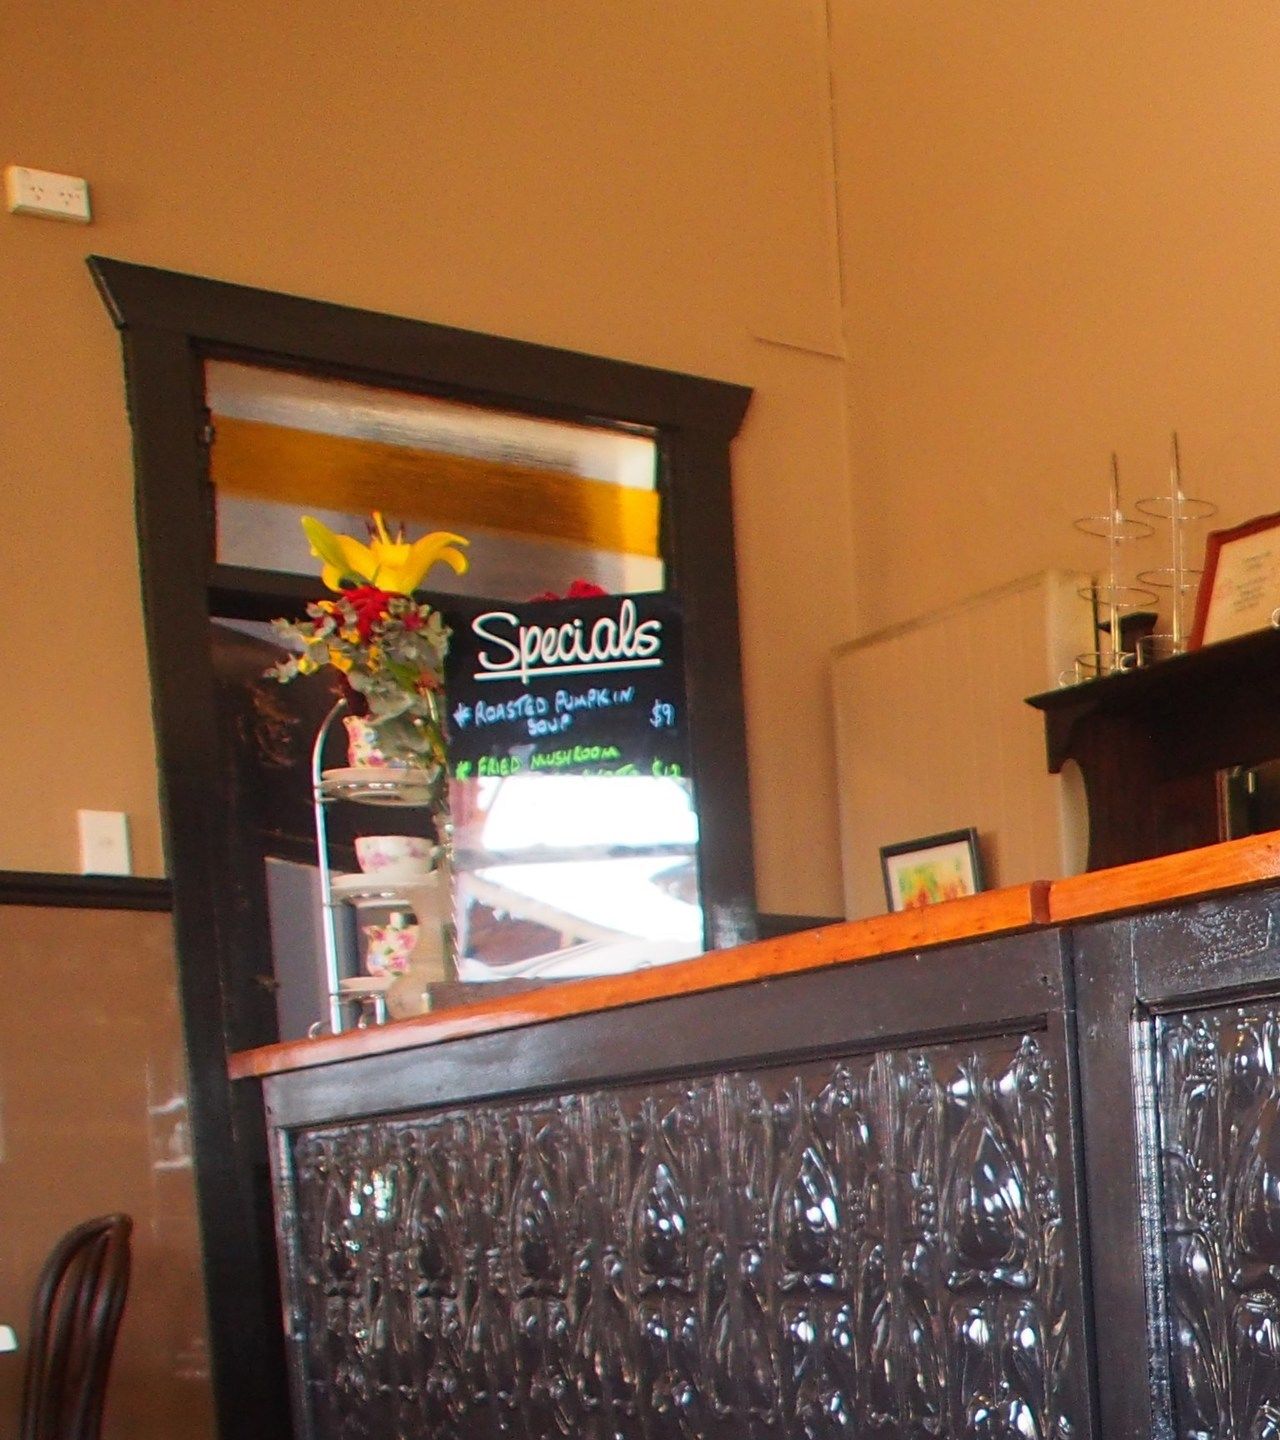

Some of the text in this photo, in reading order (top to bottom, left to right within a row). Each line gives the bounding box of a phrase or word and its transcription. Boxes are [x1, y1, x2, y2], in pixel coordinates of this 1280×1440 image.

[471, 598, 664, 684] Specials
[474, 685, 676, 729] ROASTED PUMPKIN $9
[526, 713, 574, 737] SOUP
[477, 755, 524, 777] FRIED
[530, 744, 622, 770] MUSHROOM
